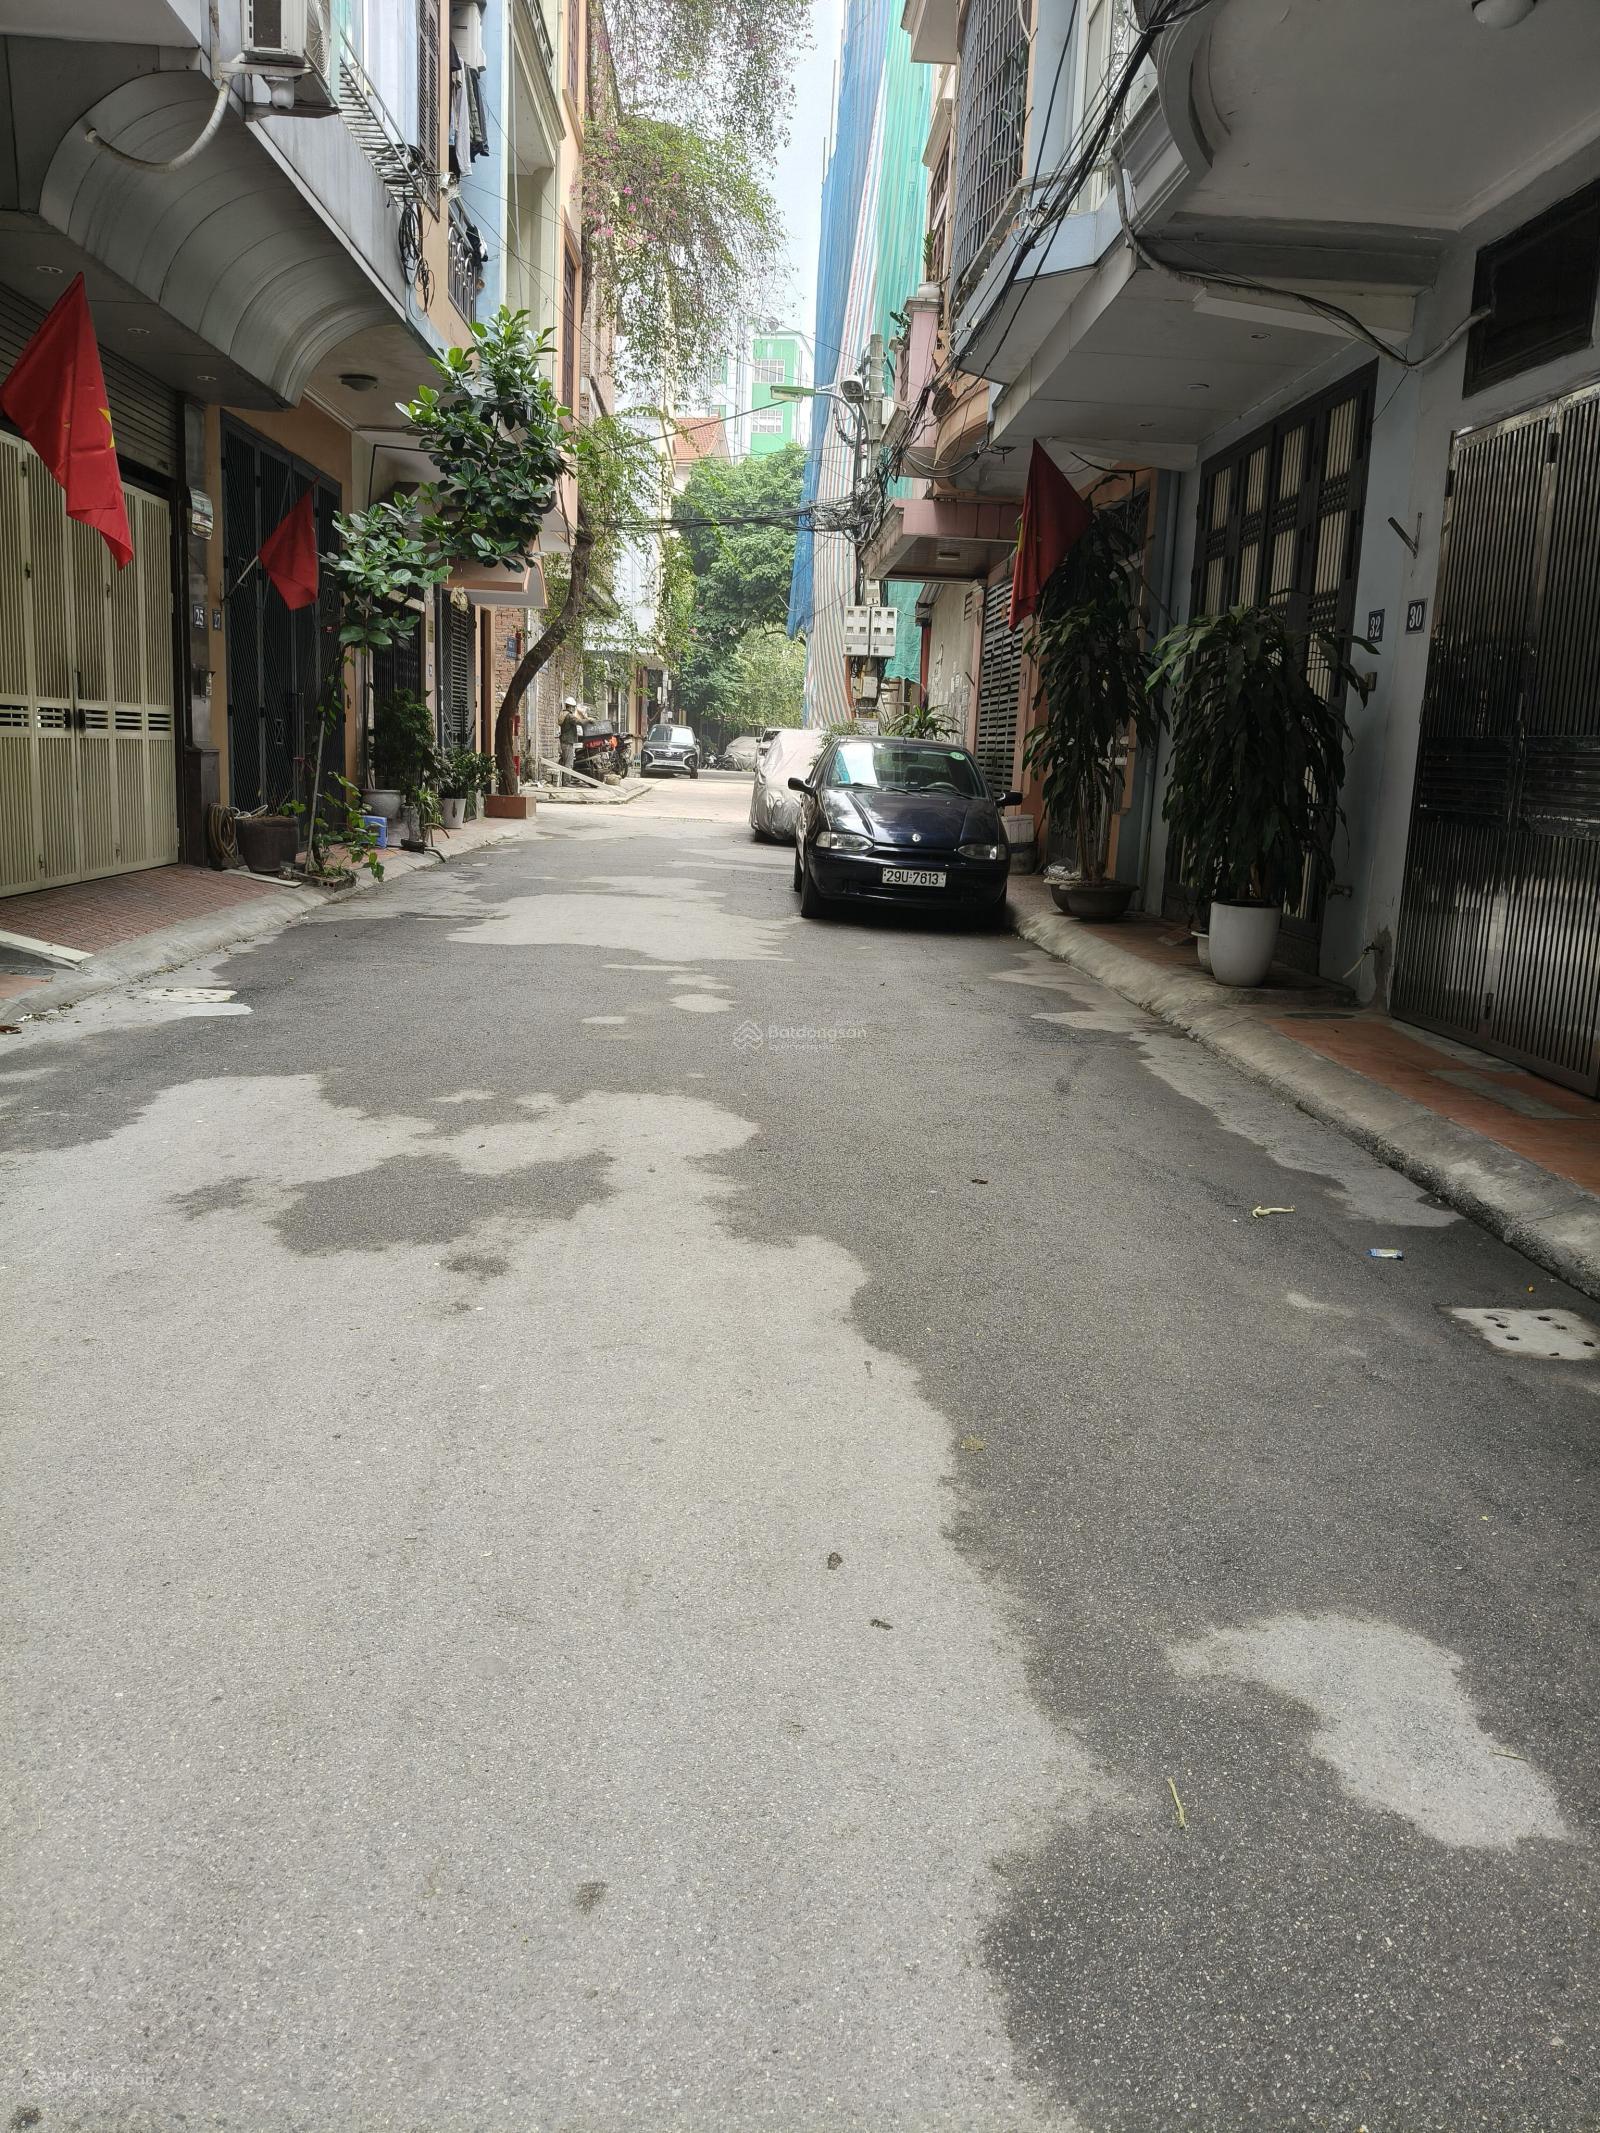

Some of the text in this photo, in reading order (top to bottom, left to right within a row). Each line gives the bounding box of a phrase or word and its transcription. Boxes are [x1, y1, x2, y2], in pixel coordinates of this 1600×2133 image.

[195, 608, 204, 626] 25
[1409, 604, 1422, 628] 30
[1370, 616, 1381, 638] 32
[886, 870, 939, 885] 29U-7613
